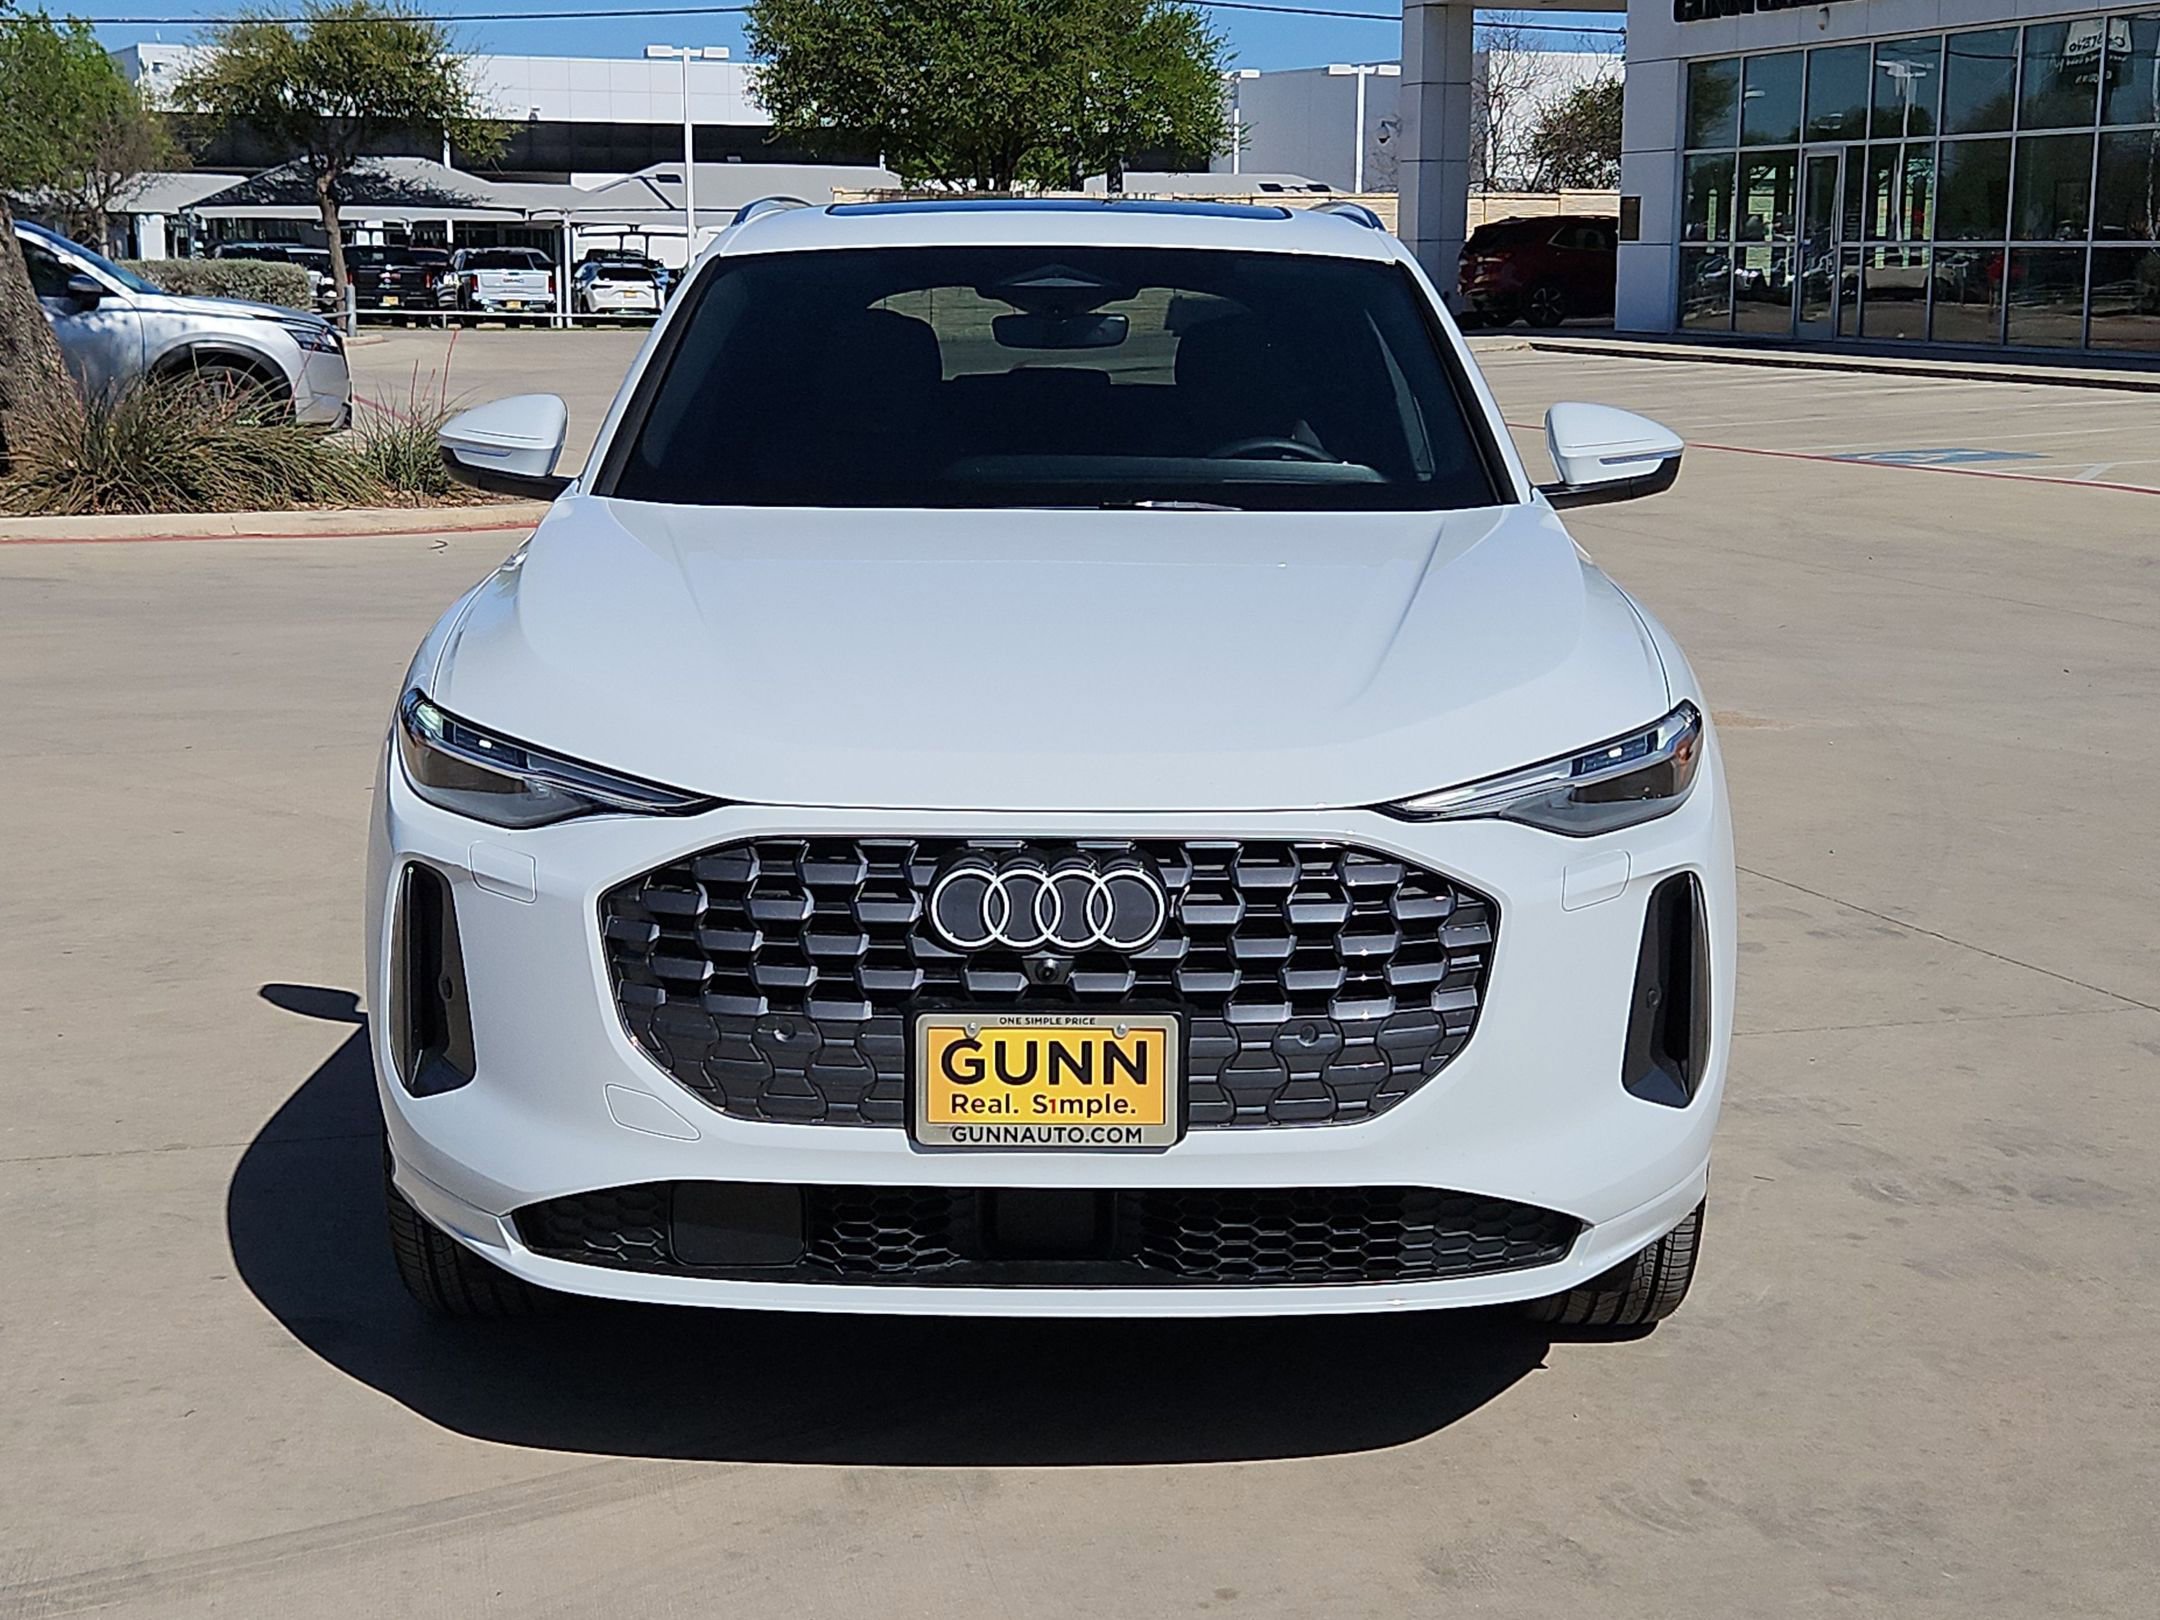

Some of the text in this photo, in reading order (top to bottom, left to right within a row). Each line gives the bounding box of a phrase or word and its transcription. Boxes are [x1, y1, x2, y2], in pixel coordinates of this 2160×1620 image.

[999, 1016, 1096, 1025] ONE SIMPLE PRICE
[941, 1039, 1147, 1085] GUNN
[951, 1093, 1019, 1113] Real.
[951, 1126, 1141, 1143] GUNNAUTO.COM
